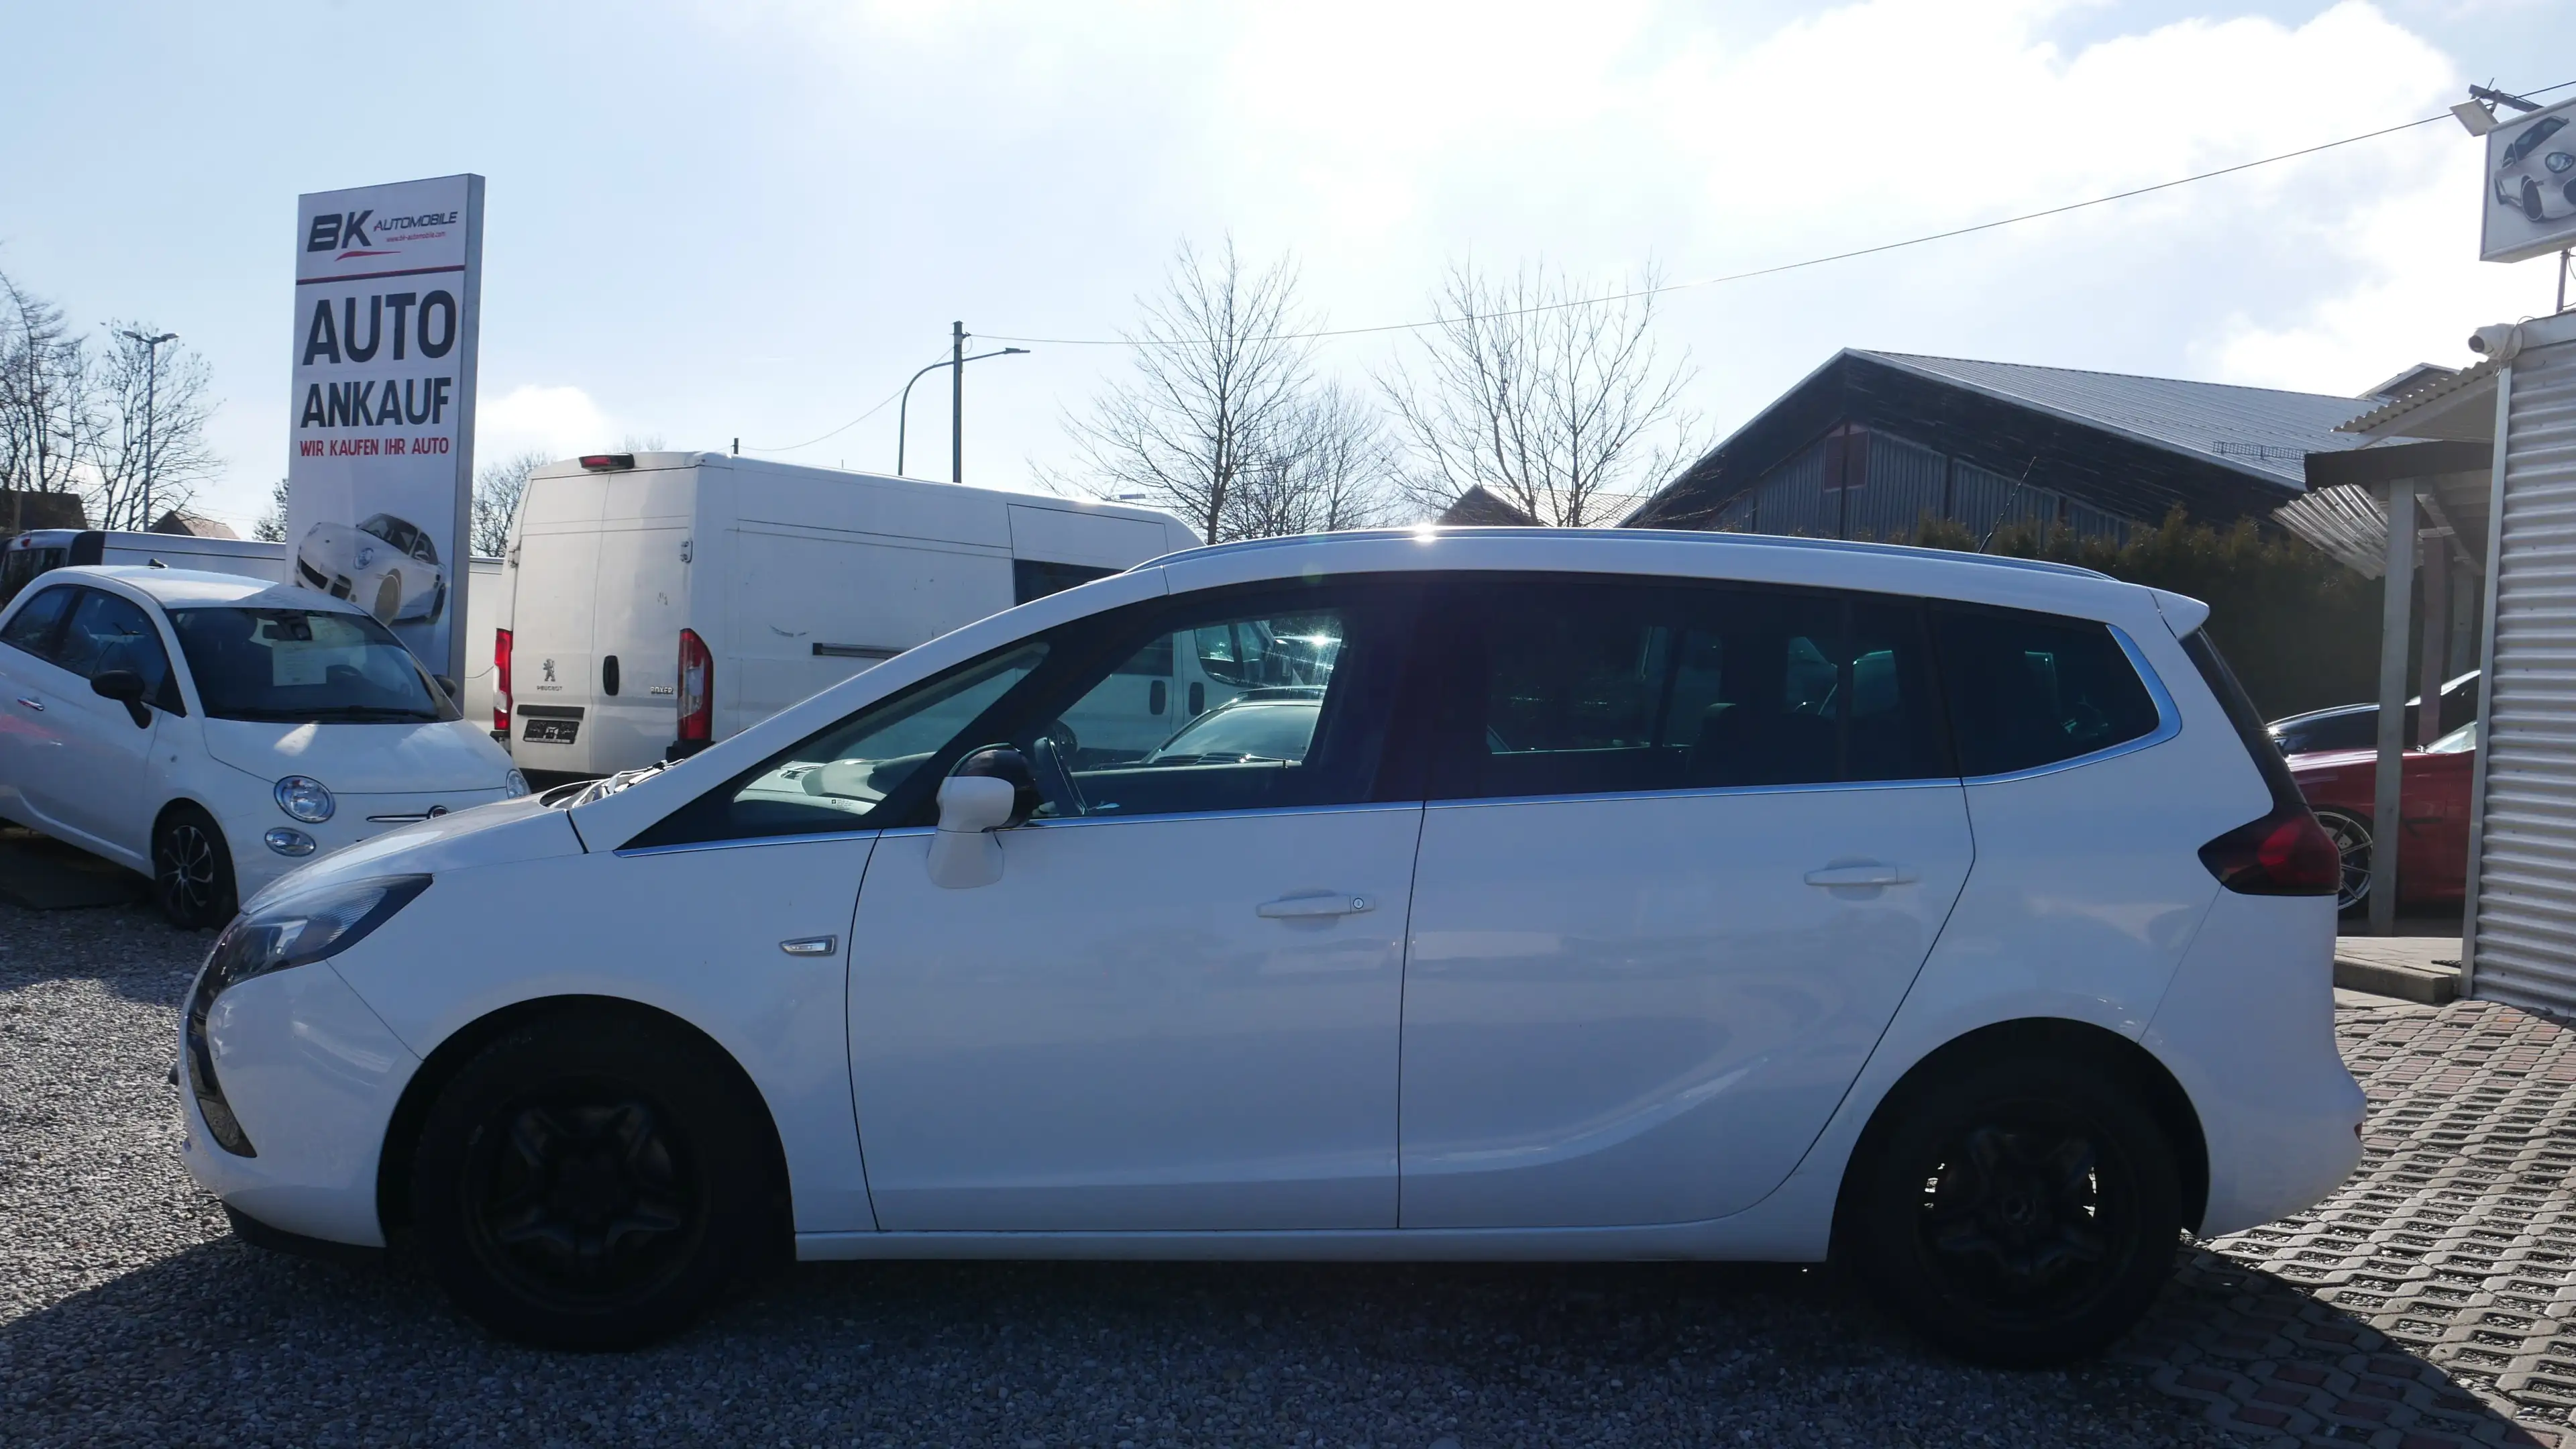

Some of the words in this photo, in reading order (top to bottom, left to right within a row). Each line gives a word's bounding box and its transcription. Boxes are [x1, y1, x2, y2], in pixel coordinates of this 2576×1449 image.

[307, 210, 374, 252] BK
[374, 211, 458, 231] AUTOMOBILE
[303, 290, 456, 366] AUTO
[301, 377, 451, 428] ANKAUF
[300, 440, 324, 457] WIR
[330, 439, 379, 456] KAUFEN
[384, 438, 406, 455] IHR
[411, 437, 449, 454] AUTO
